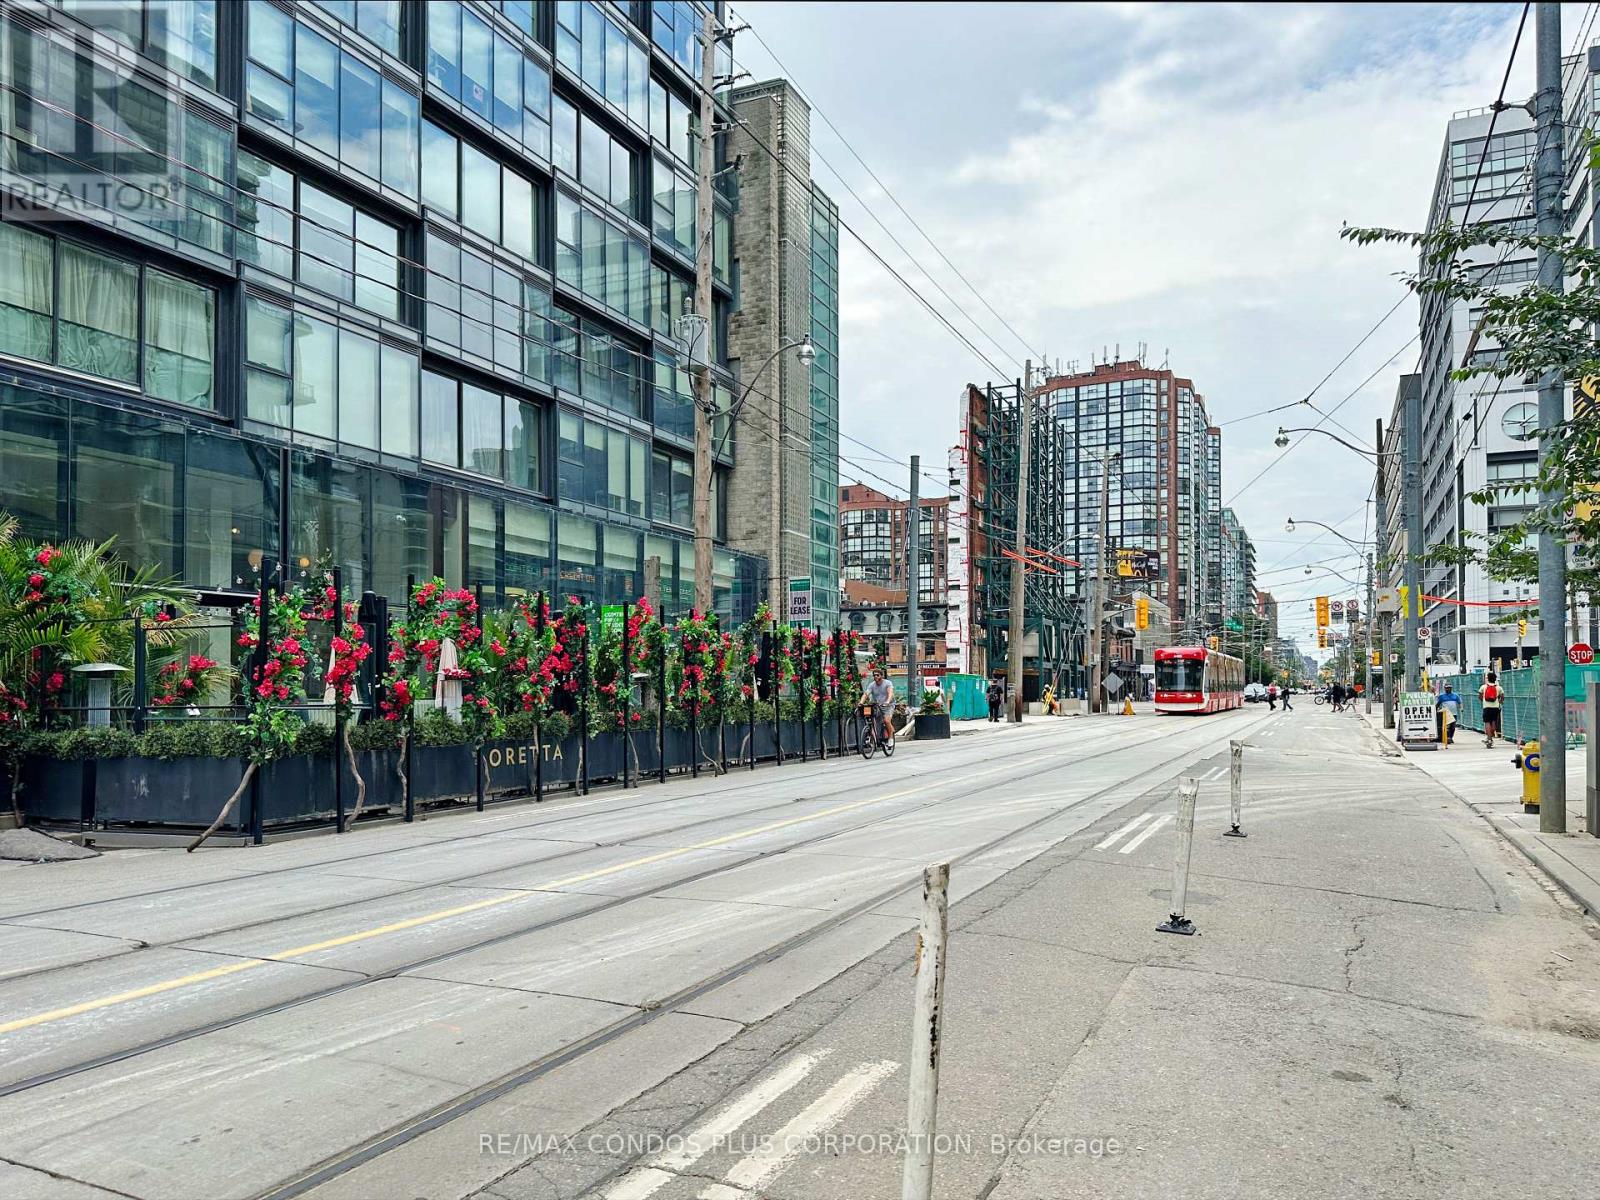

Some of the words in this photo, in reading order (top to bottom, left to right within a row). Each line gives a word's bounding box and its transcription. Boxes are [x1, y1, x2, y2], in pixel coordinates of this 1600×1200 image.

[793, 597, 807, 605] FOR
[790, 606, 811, 615] LEASE
[1570, 650, 1593, 660] STOP
[1405, 706, 1432, 715] OPEN
[489, 744, 563, 767] ORETTA
